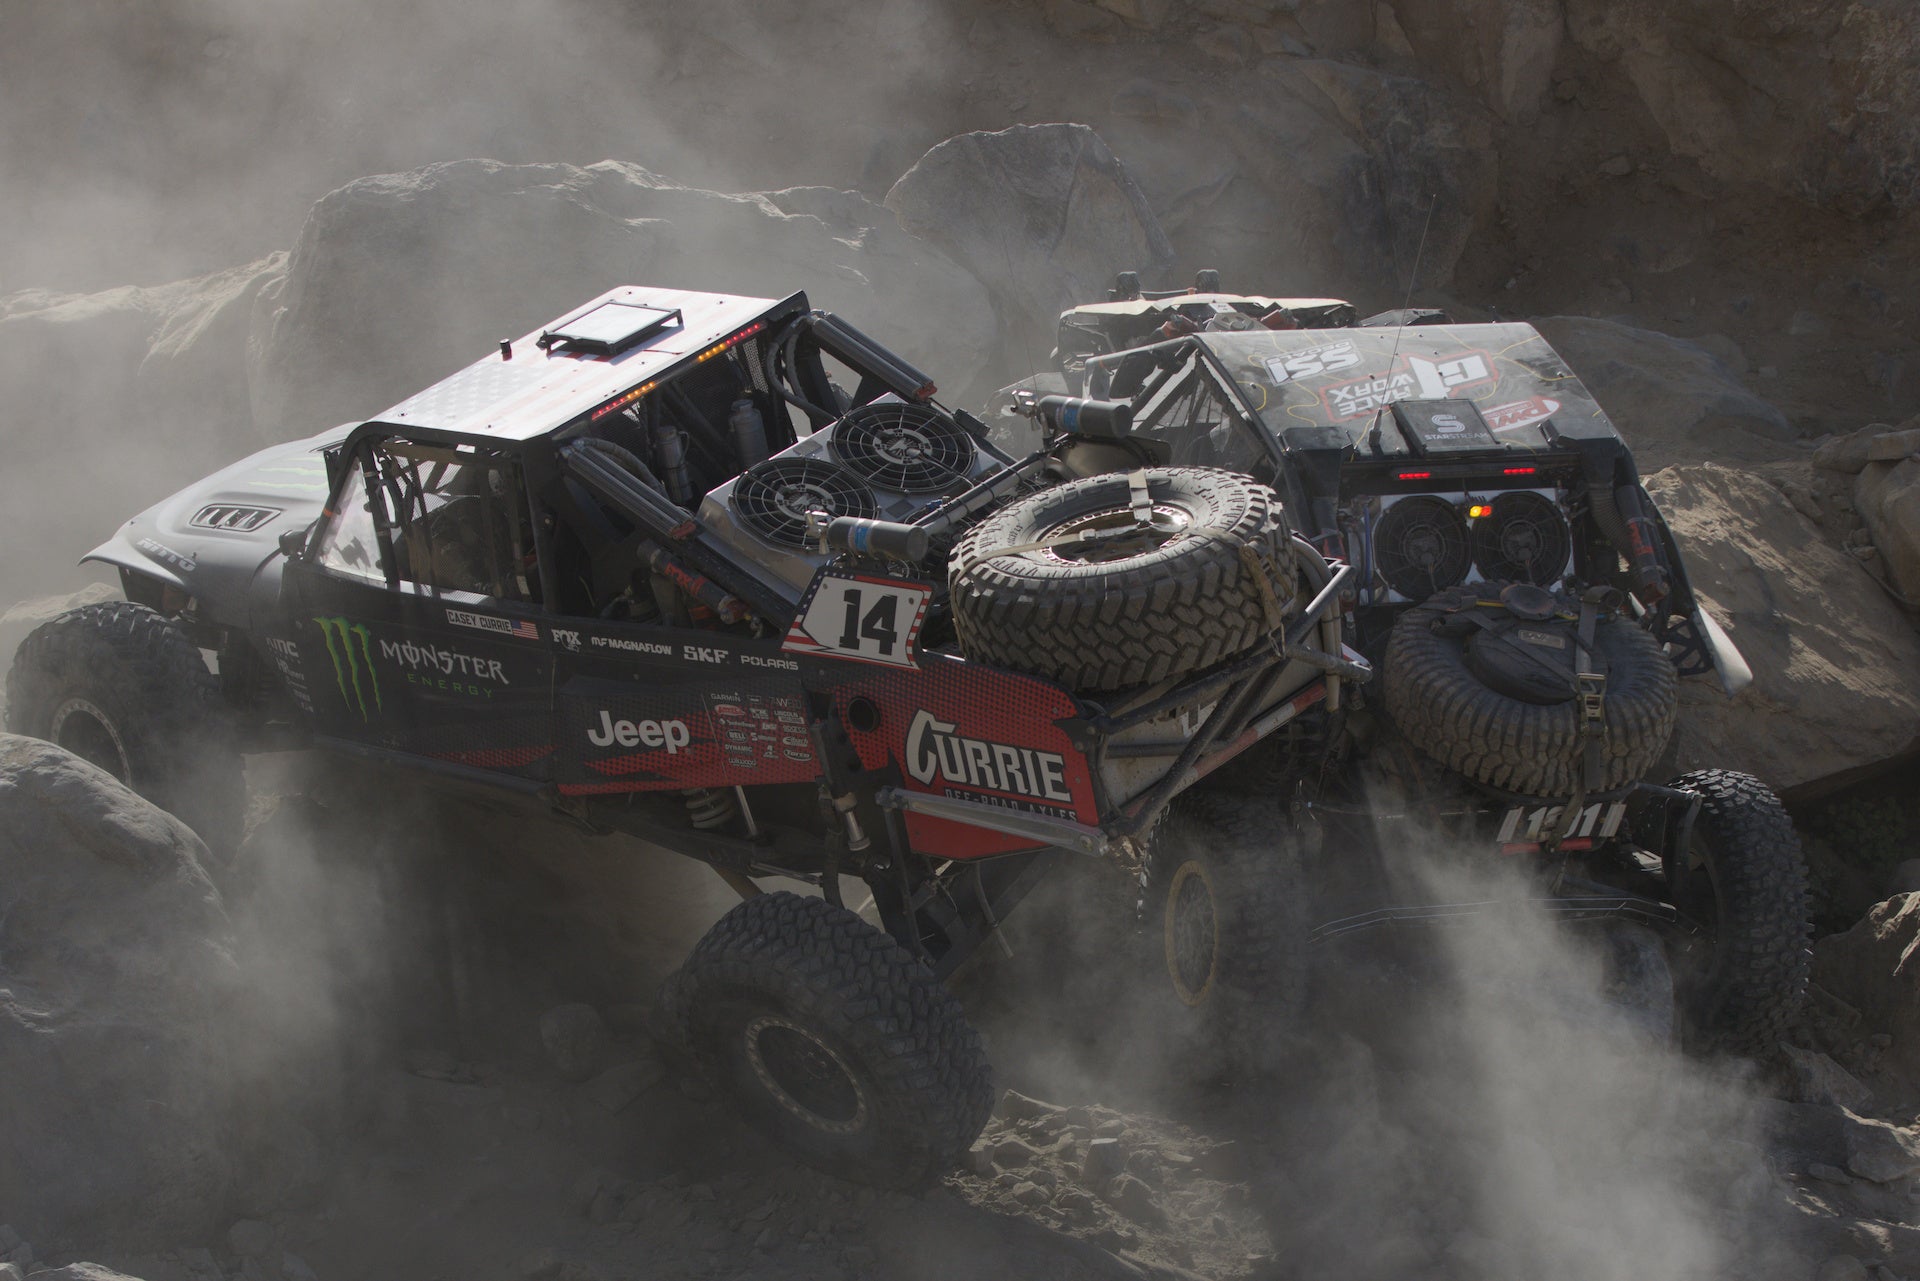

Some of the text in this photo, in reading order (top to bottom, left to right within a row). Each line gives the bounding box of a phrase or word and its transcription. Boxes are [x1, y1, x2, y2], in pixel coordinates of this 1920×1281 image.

[1328, 373, 1415, 404] WORX
[1338, 385, 1412, 416] RACE
[448, 611, 512, 634] CASEY CURRIE
[838, 588, 898, 656] 14
[551, 629, 582, 647] FOX
[609, 638, 672, 656] MAGNAFLOW
[380, 639, 509, 685] MONSTER
[683, 645, 729, 664] SKF
[740, 654, 799, 671] POLARIS
[407, 673, 492, 698] ENERGY
[710, 692, 741, 704] GARMIN
[587, 710, 690, 754] Jeep
[906, 709, 1072, 803] CURRIE
